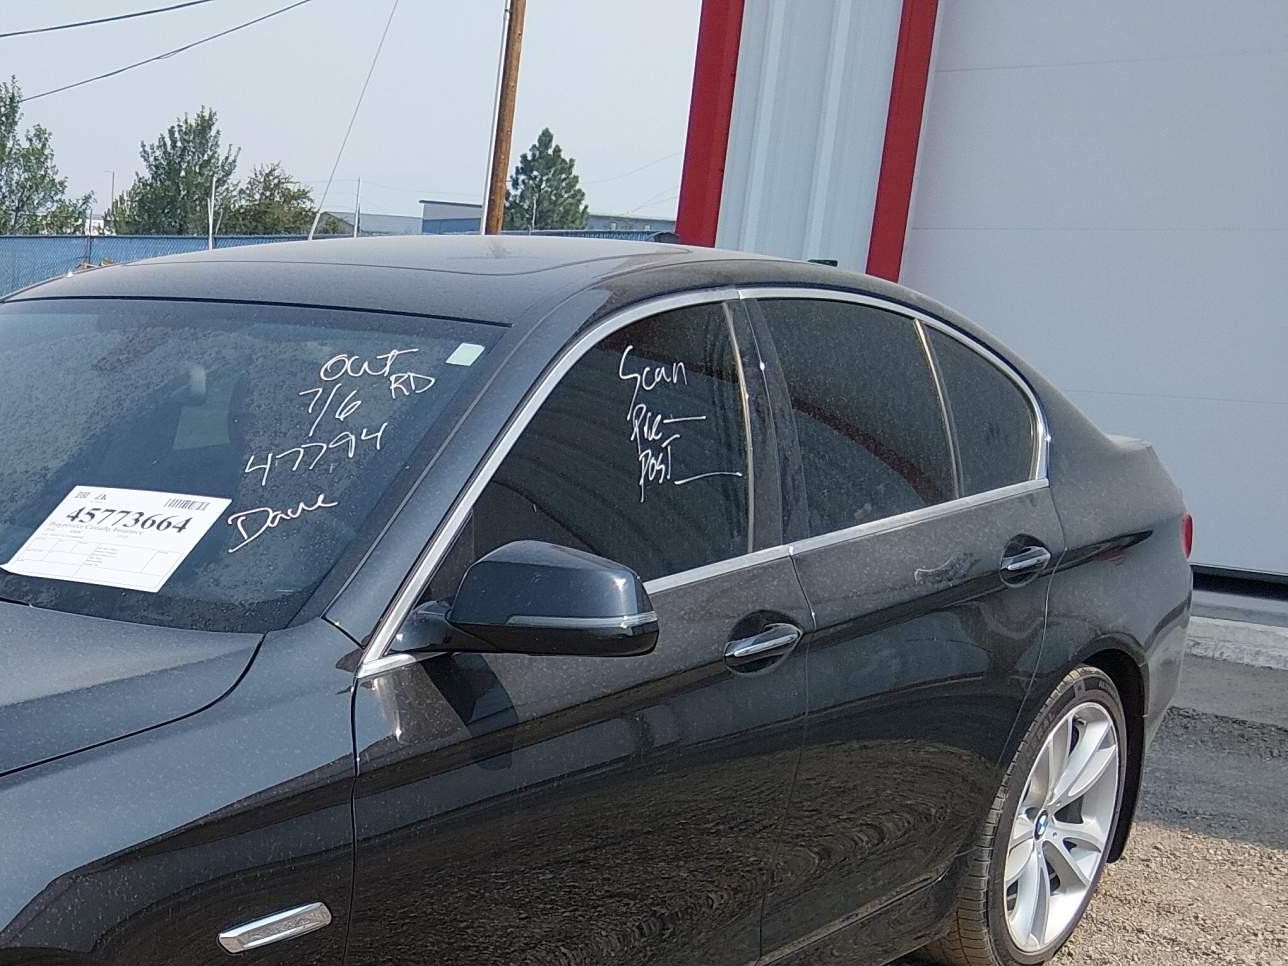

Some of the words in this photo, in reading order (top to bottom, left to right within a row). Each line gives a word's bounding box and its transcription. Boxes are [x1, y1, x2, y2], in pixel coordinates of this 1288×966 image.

[299, 383, 362, 437] 7/6
[389, 372, 435, 399] RD
[619, 345, 688, 421] Scan
[244, 422, 388, 486] 47794
[66, 506, 193, 534] 45773664
